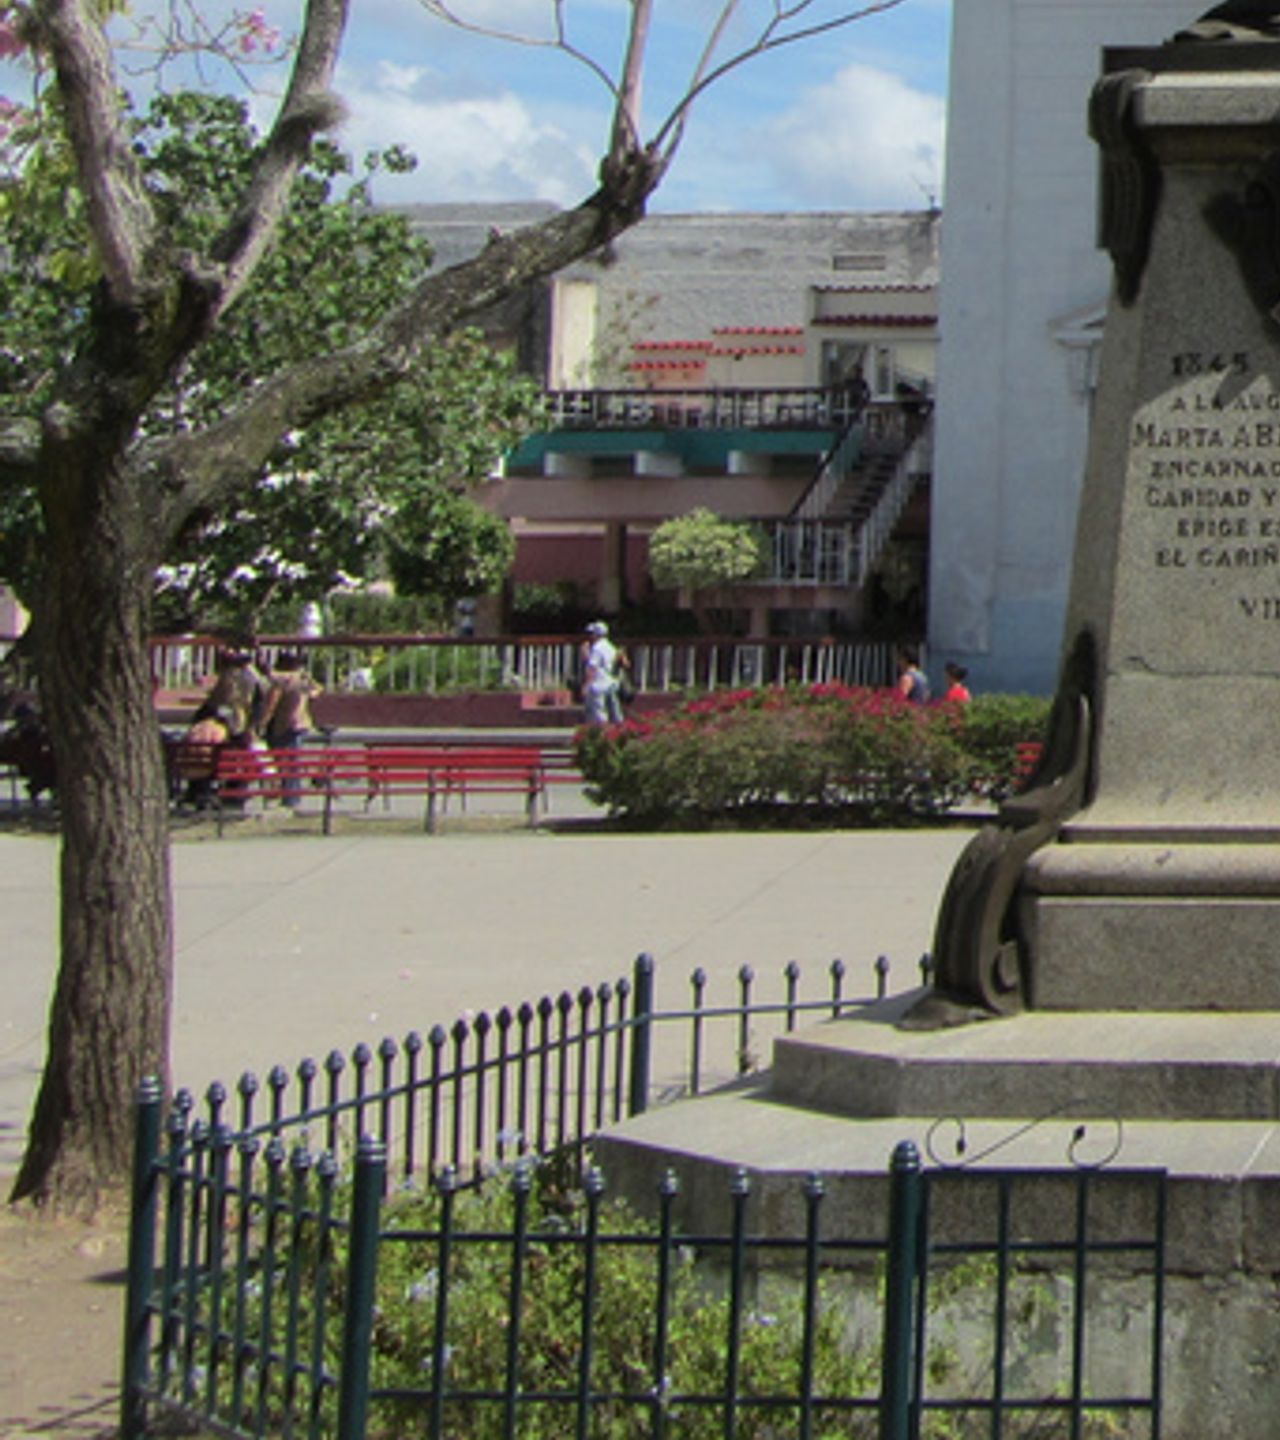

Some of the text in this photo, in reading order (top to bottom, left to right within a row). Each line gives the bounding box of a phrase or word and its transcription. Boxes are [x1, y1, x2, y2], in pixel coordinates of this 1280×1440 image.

[1172, 351, 1249, 376] 1845
[1172, 395, 1187, 411] A
[1194, 393, 1224, 411] LA
[1132, 423, 1224, 449] MARTA
[1146, 486, 1252, 508] CARIDAD
[1261, 486, 1277, 507] Y
[1176, 517, 1250, 538] ERIGE
[1154, 547, 1187, 568] EL
